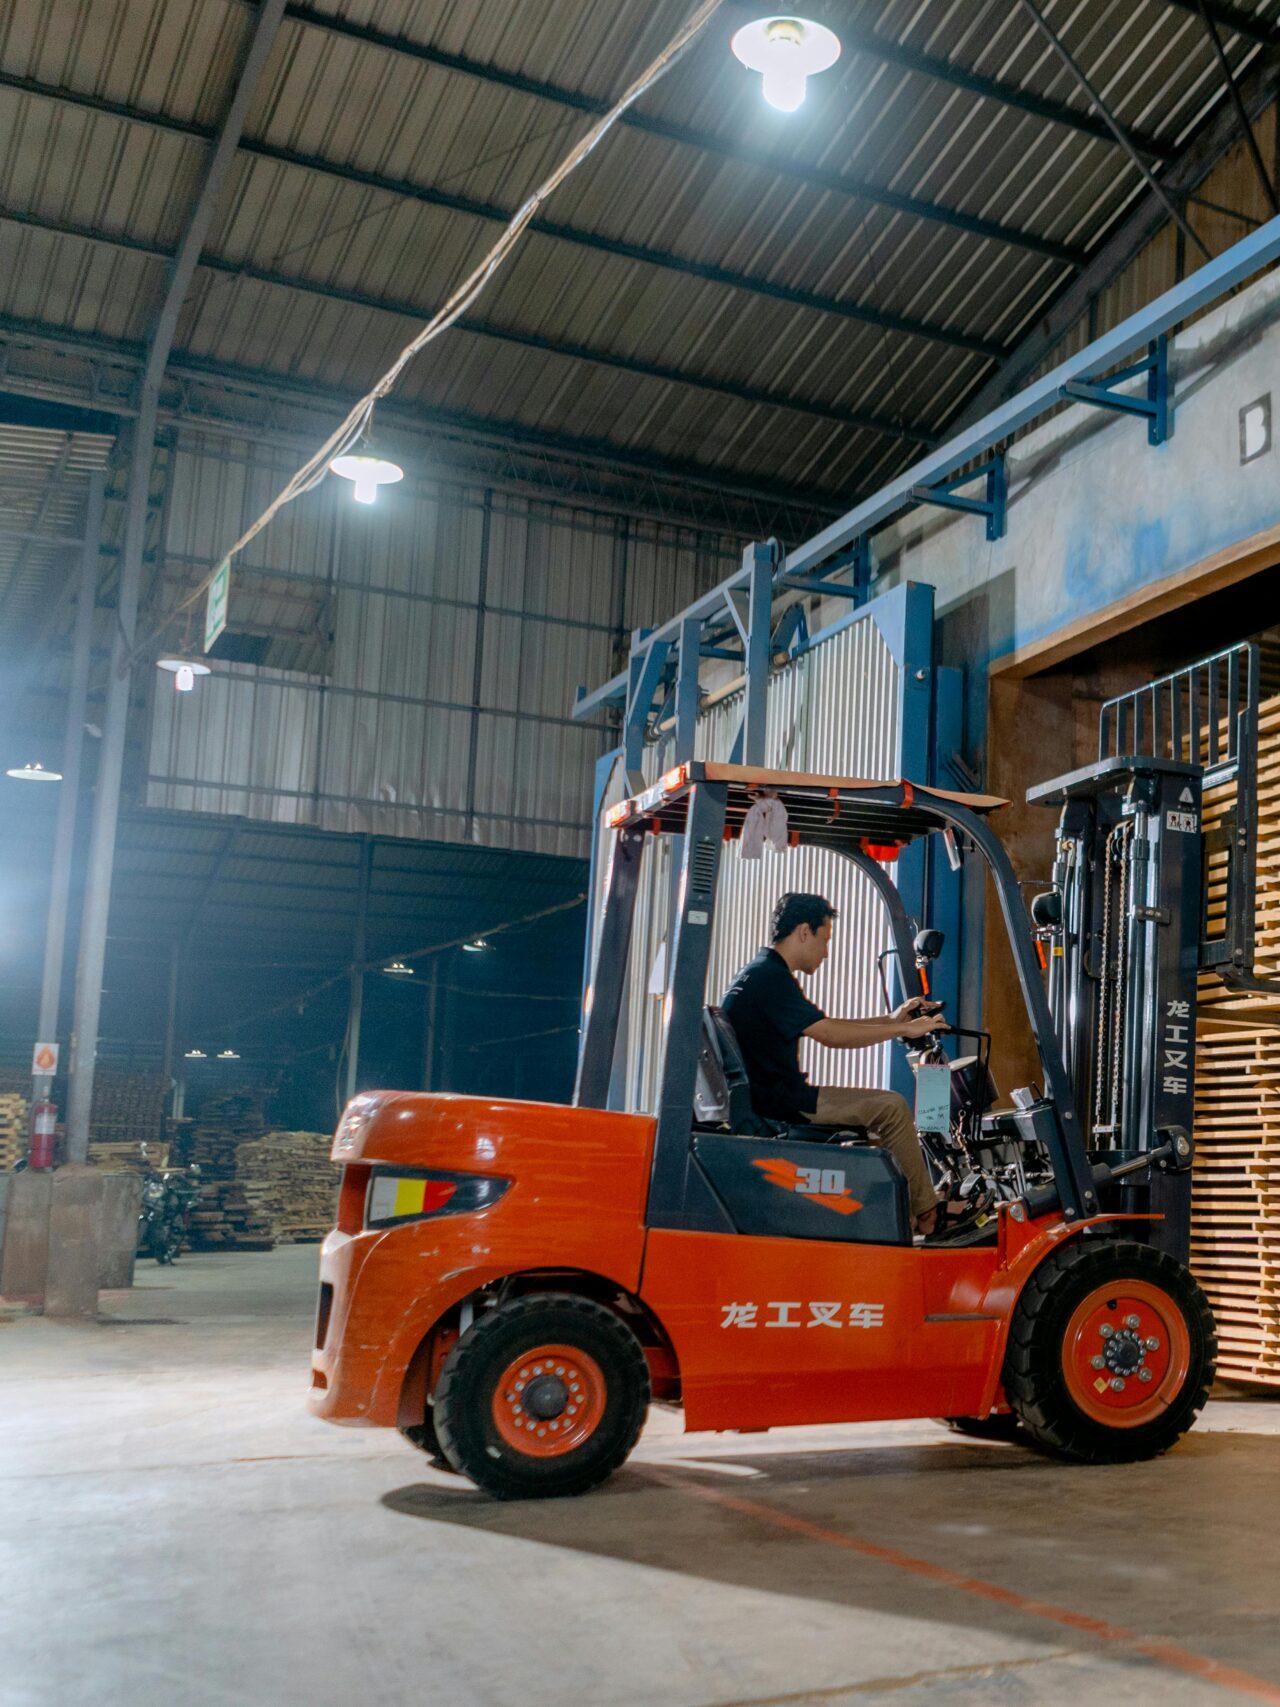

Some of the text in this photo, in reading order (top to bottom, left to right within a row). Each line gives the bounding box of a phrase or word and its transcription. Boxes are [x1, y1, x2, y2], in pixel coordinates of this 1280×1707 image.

[795, 1167, 846, 1194] 30
[720, 1301, 885, 1329] 龙工叉车
